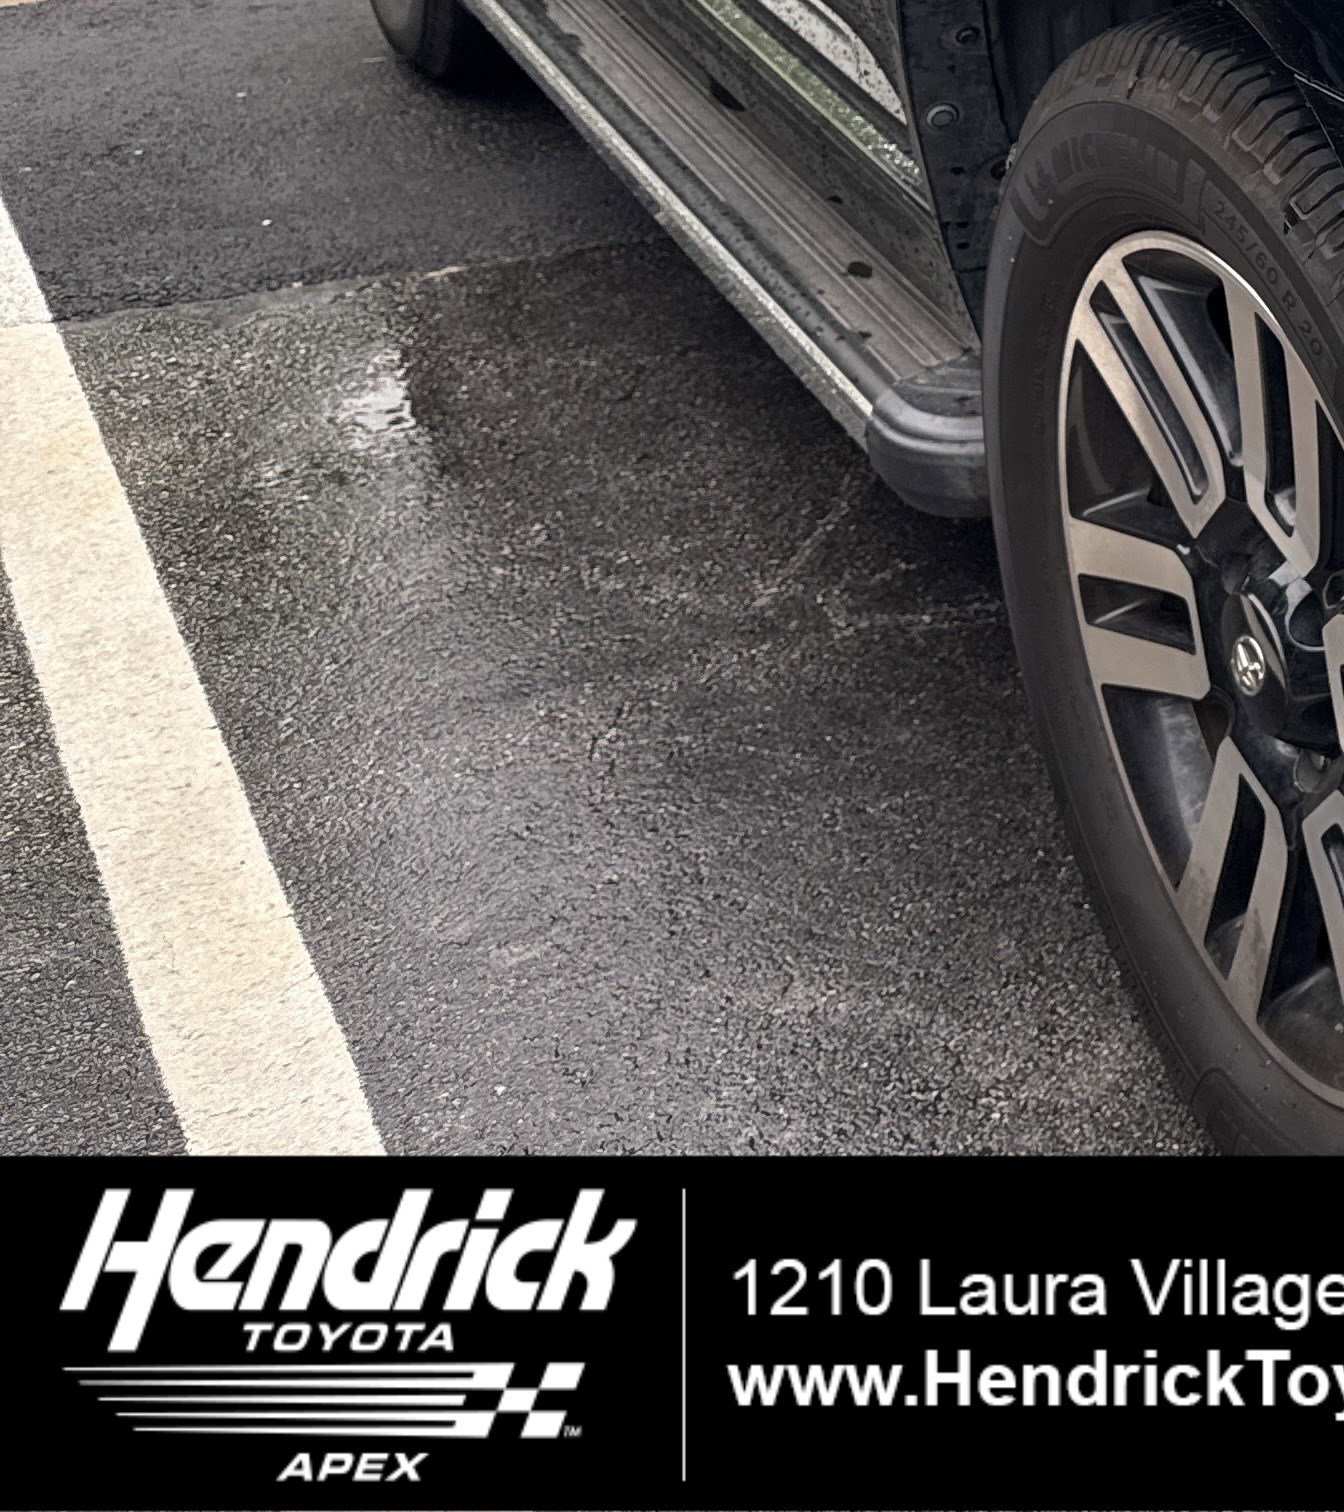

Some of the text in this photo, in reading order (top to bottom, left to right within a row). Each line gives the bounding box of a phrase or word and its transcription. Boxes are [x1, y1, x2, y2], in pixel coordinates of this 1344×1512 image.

[1214, 199, 1324, 357] 245/60 R 20
